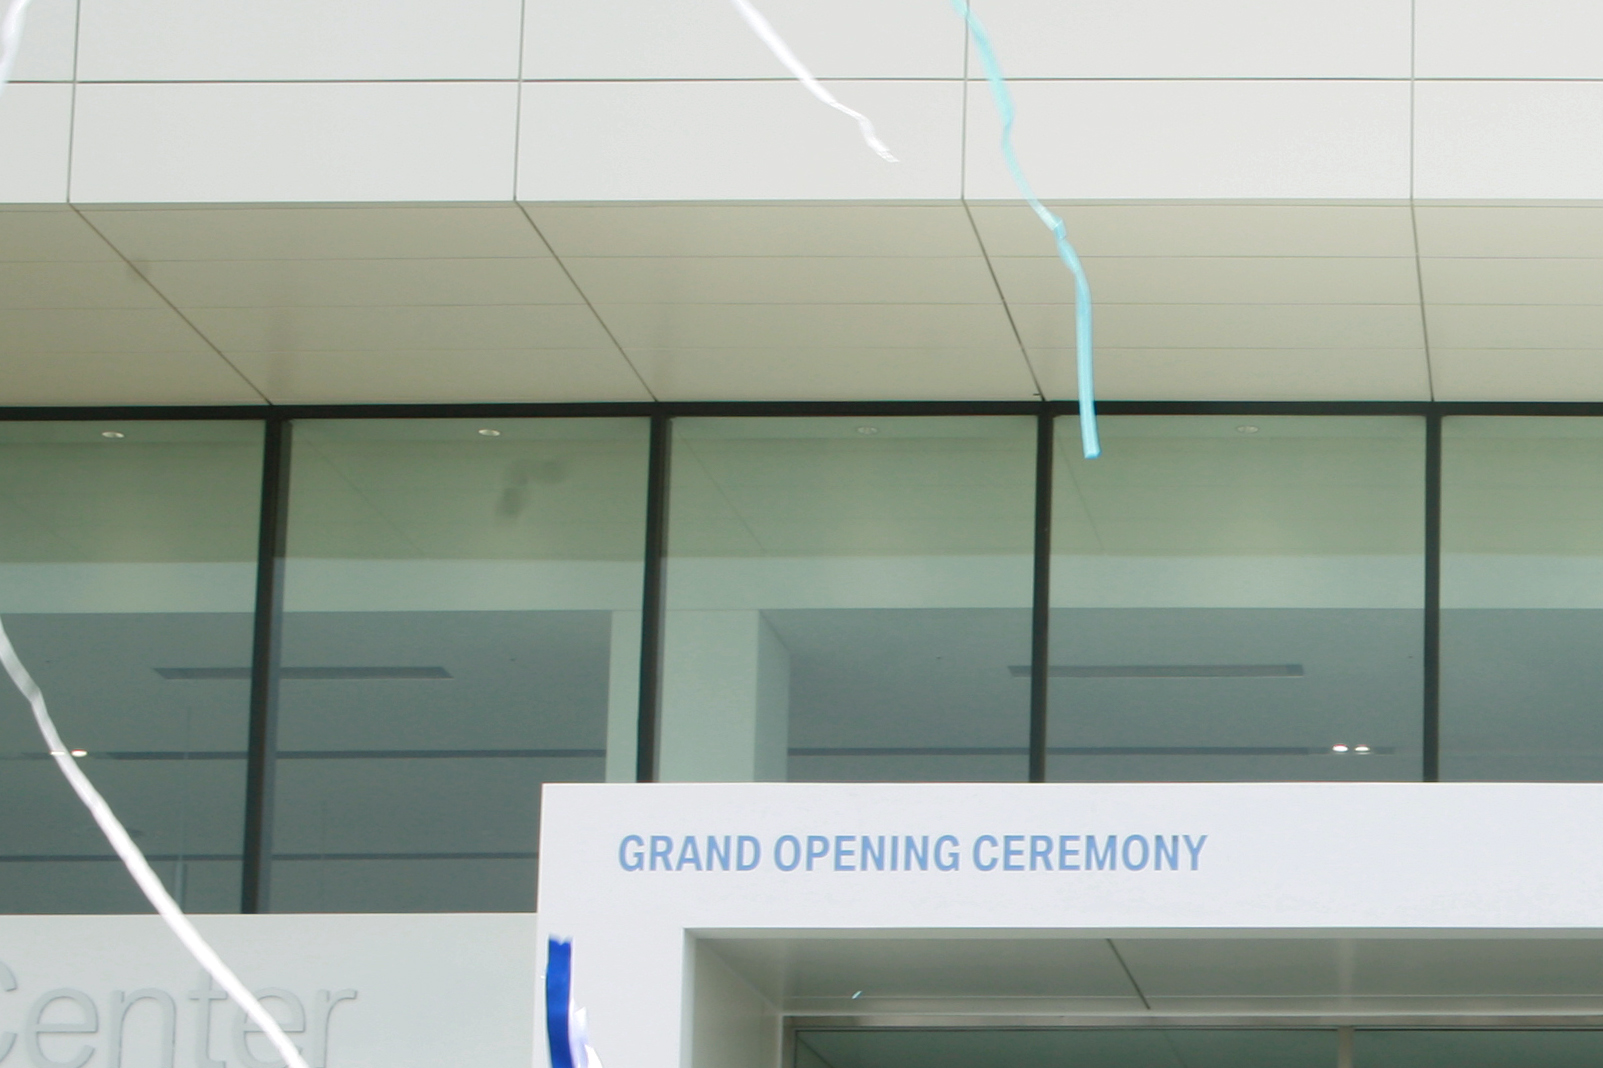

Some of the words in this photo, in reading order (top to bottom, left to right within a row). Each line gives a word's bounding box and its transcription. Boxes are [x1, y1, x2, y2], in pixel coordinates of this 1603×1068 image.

[618, 834, 762, 872] GRAND
[773, 834, 960, 872] OPENING
[972, 834, 1208, 872] CEREMONY
